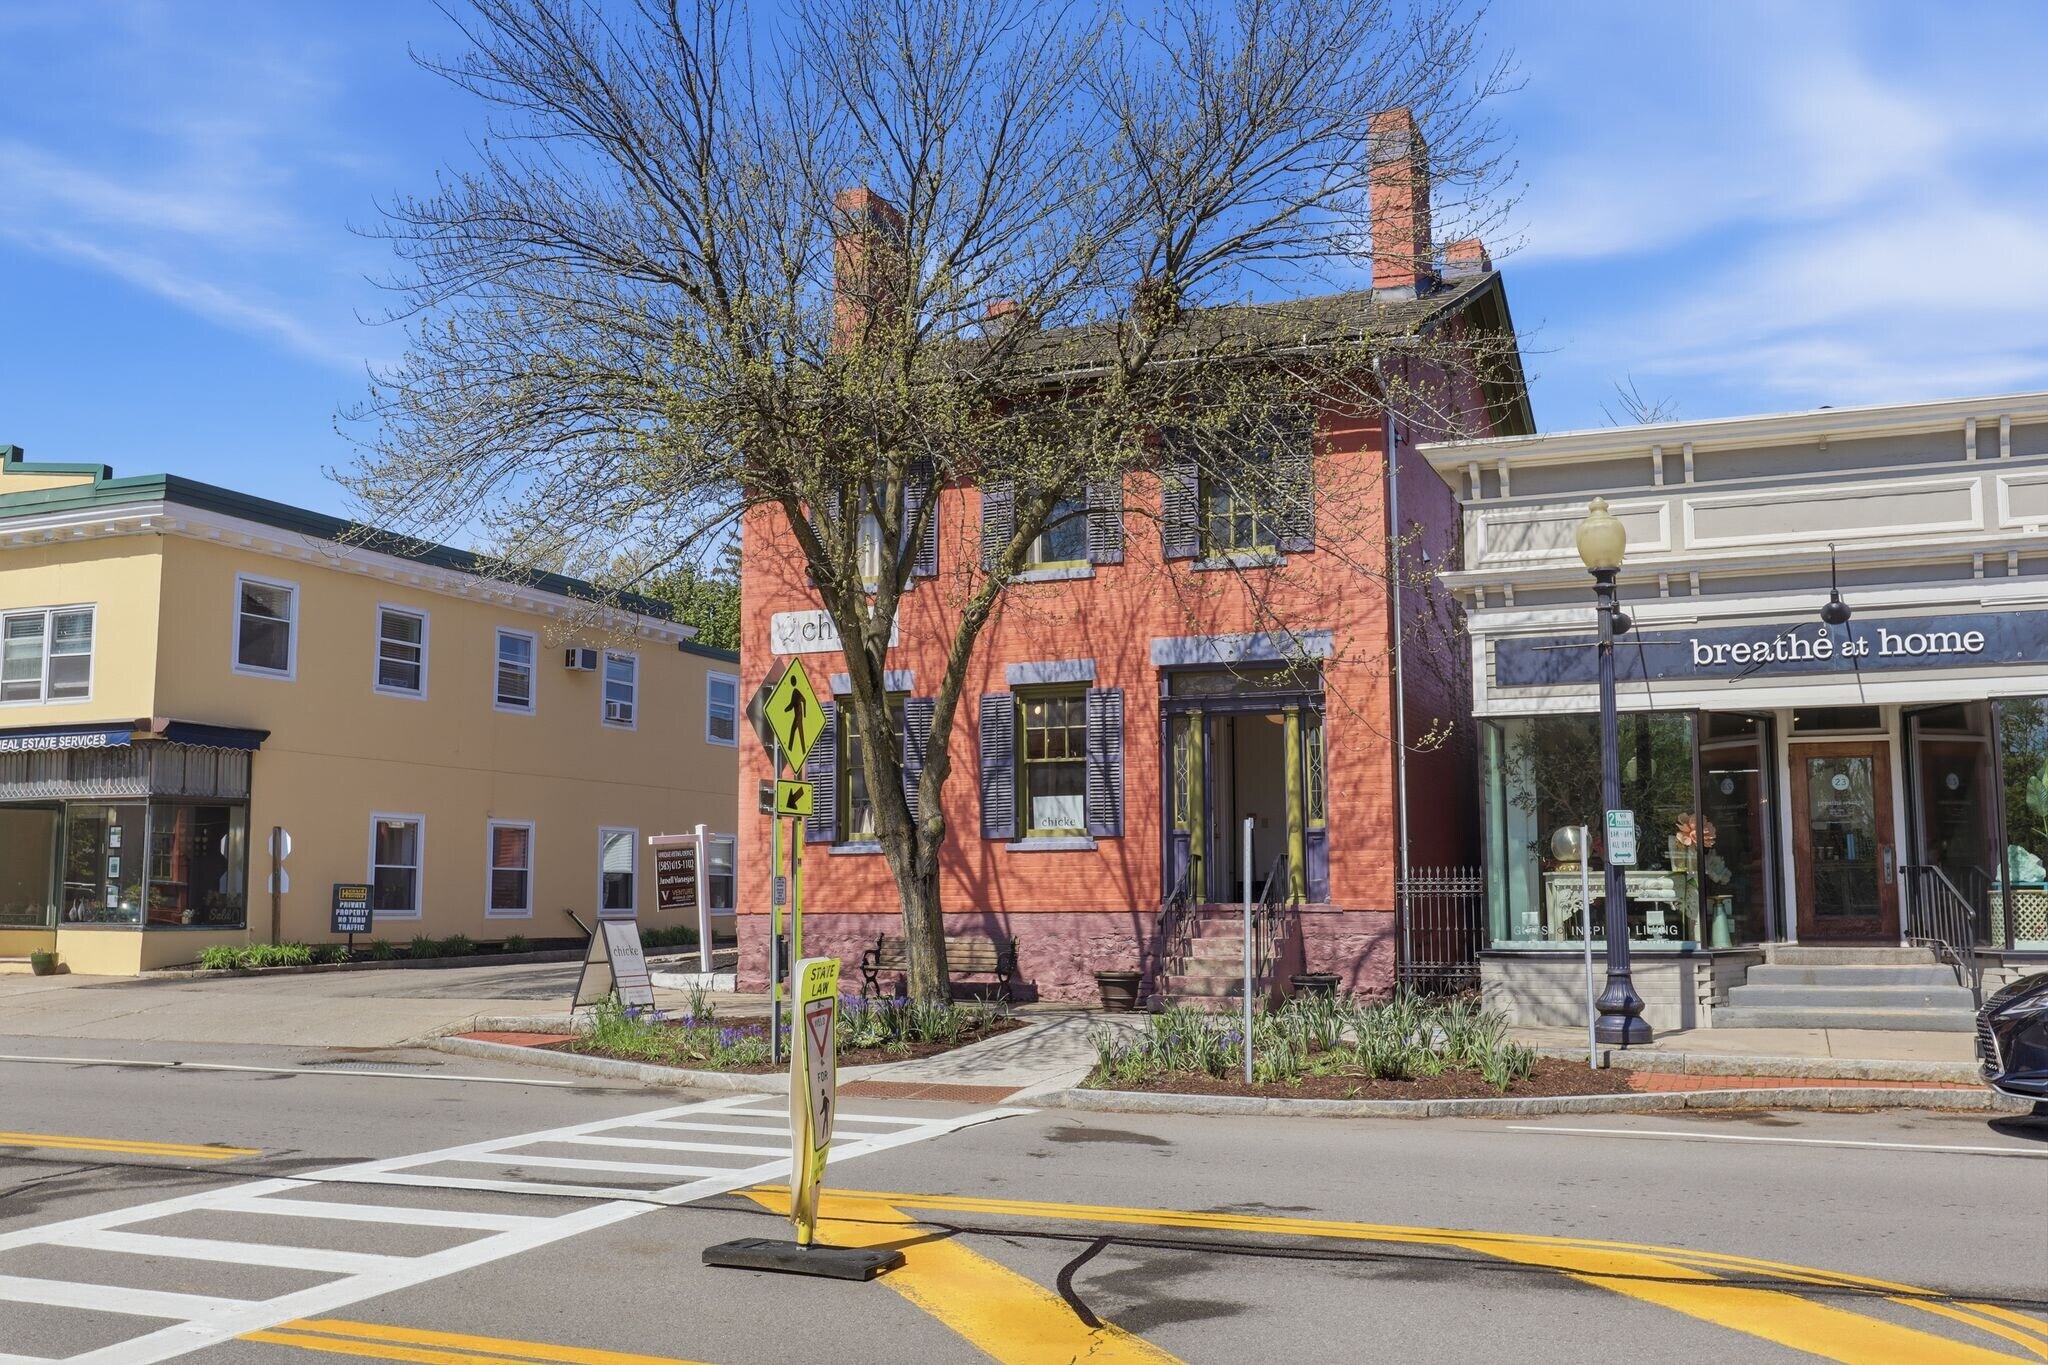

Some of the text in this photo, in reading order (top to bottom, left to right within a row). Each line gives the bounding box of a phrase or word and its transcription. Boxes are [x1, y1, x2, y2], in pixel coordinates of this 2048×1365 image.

[1842, 636, 1868, 656] at
[1877, 628, 1985, 656] home
[22, 737, 57, 749] ESTATE
[59, 734, 107, 747] SERVICES
[1834, 778, 1847, 786] 23
[1041, 817, 1076, 827] chicke
[1608, 812, 1616, 827] 2
[613, 945, 640, 957] chicke
[810, 964, 836, 981] STATE
[811, 982, 829, 997] LAW
[814, 1017, 826, 1028] YIELD
[817, 1070, 829, 1083] FOR
